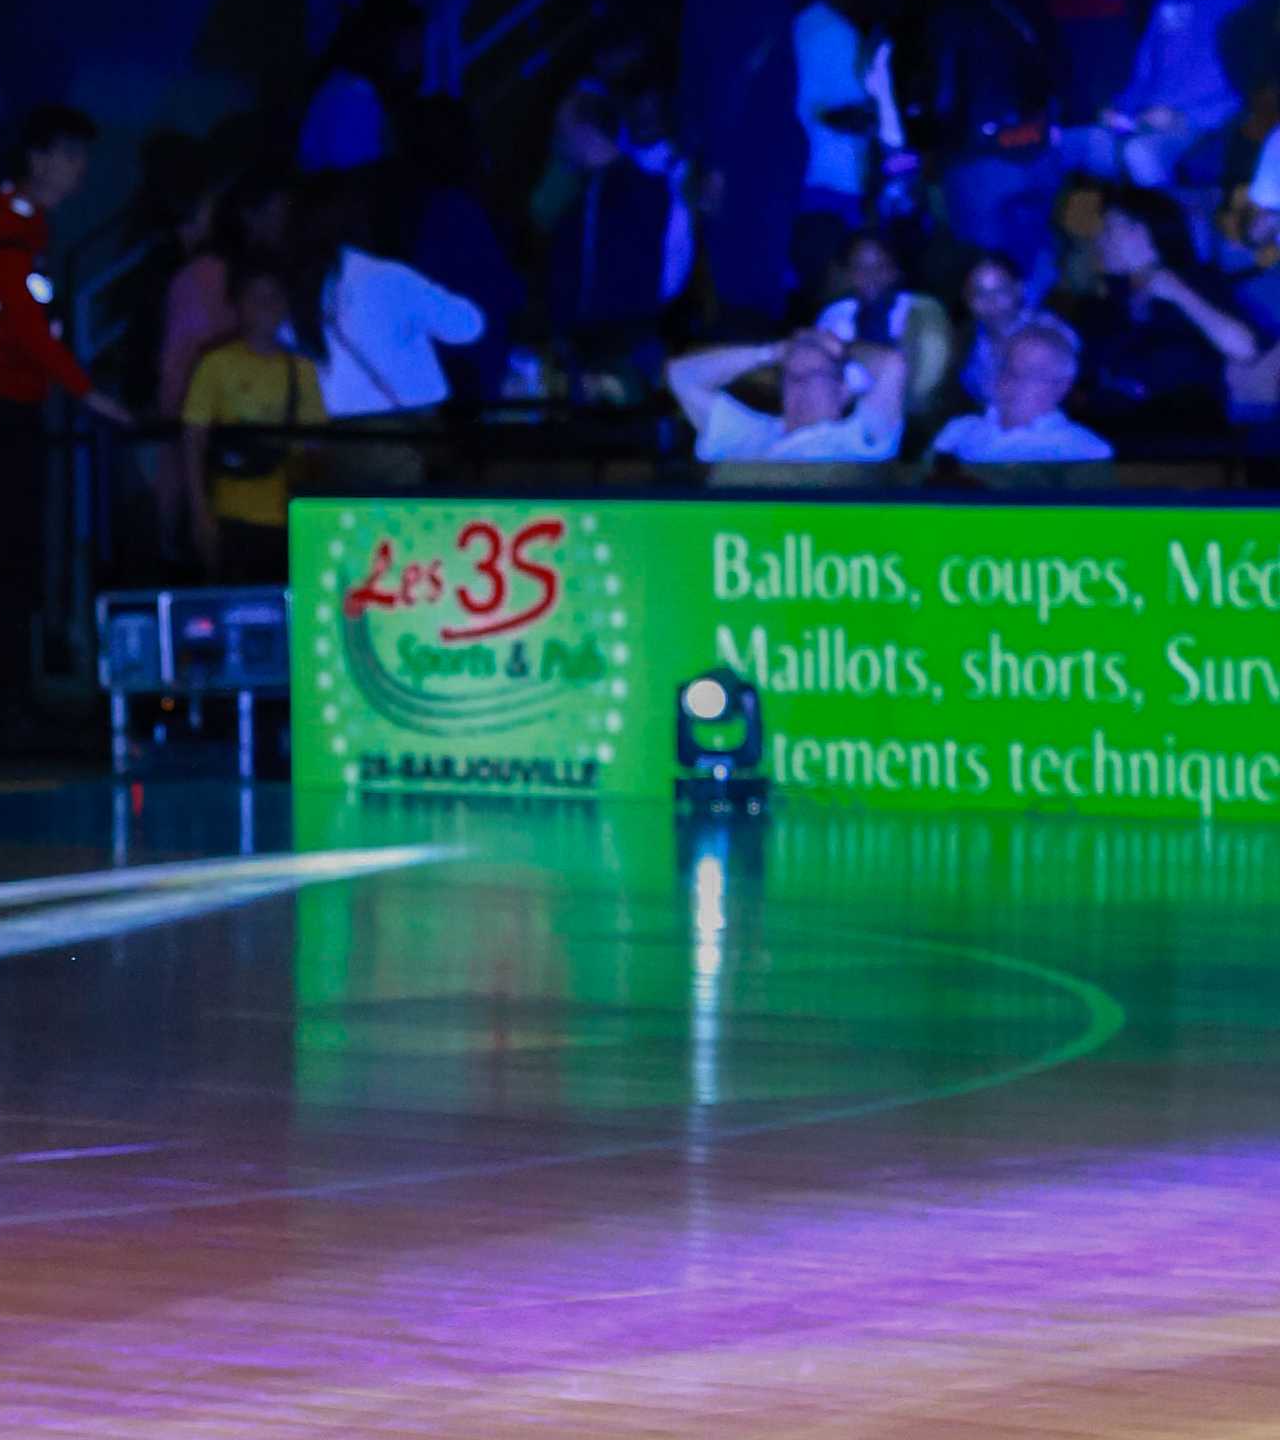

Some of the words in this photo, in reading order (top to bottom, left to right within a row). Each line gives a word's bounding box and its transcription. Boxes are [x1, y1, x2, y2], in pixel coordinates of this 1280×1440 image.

[344, 538, 444, 618] Les
[713, 531, 923, 613] Ballons,
[938, 553, 1145, 625] coupes,
[715, 623, 944, 708] Maillots,
[961, 630, 1145, 713] shorts,
[1008, 725, 1280, 822] technique
